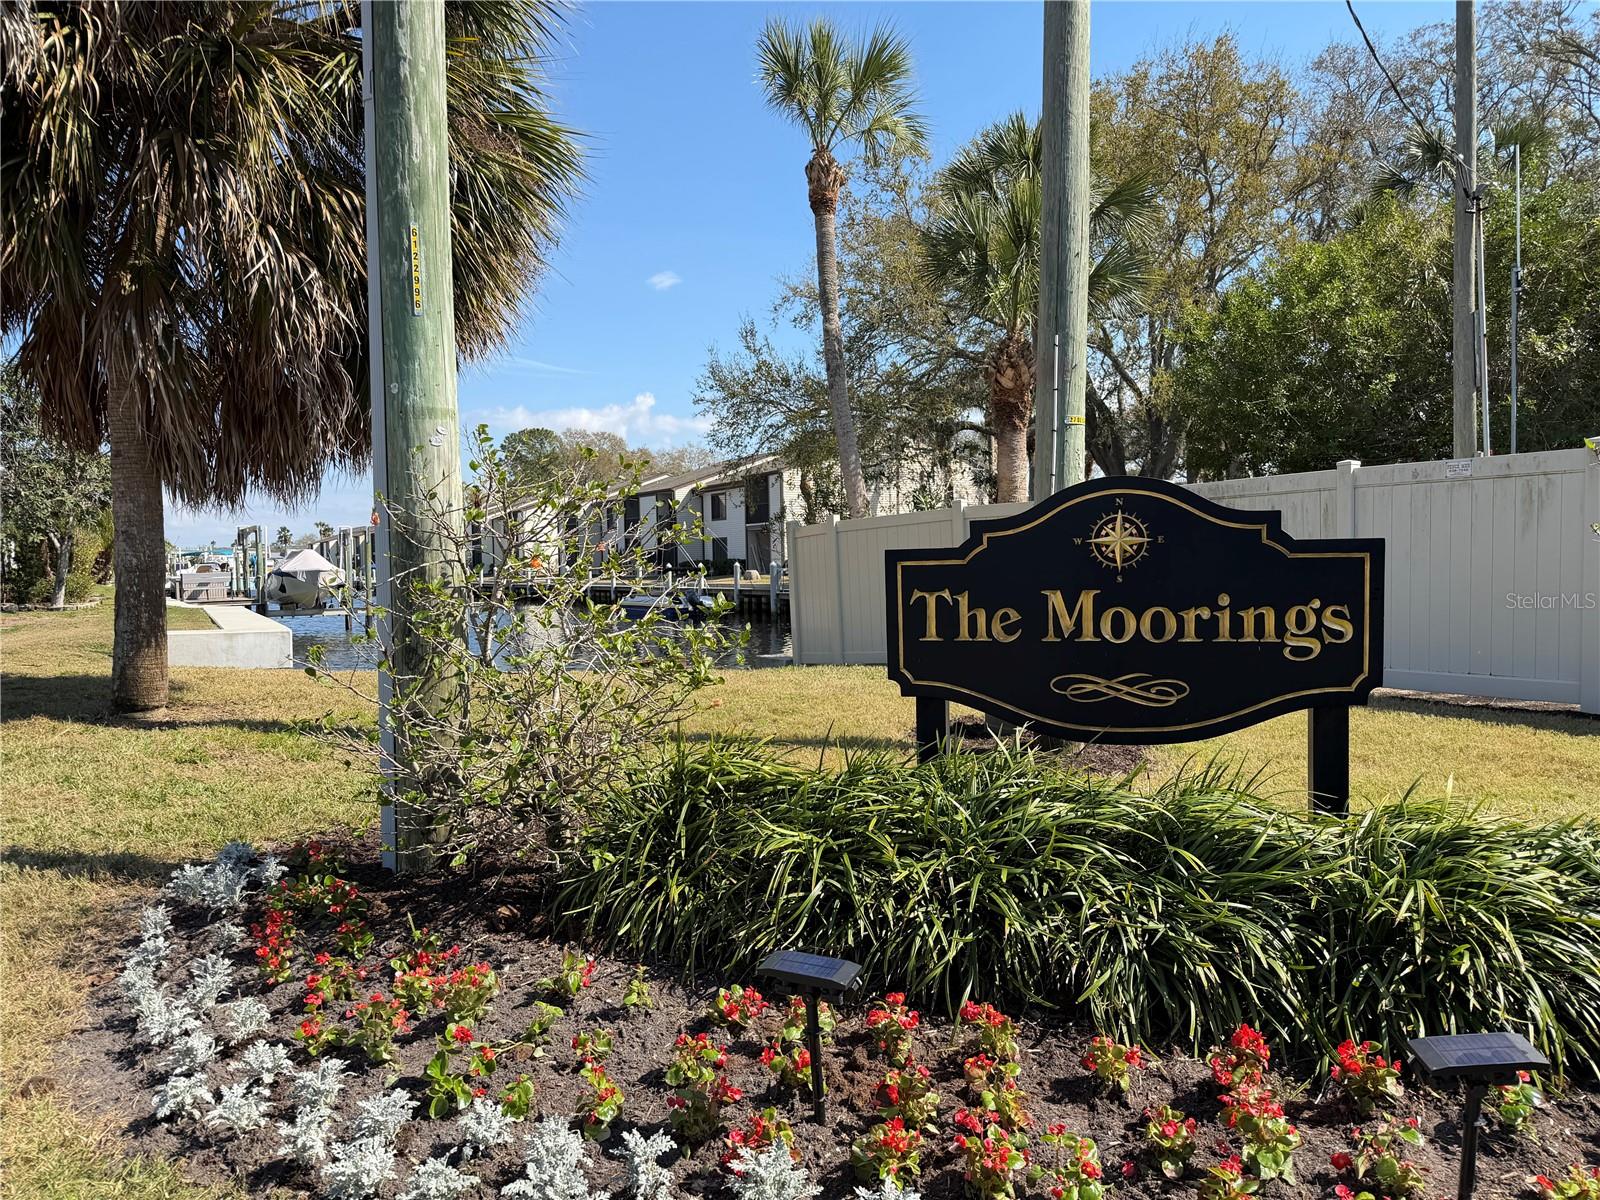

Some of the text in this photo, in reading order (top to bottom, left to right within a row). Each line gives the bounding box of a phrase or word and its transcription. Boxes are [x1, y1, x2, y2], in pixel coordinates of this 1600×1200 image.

[411, 227, 421, 309] 6122996
[1114, 497, 1124, 506] N
[1073, 537, 1083, 545] W
[1157, 535, 1165, 544] E
[1116, 575, 1123, 583] S
[909, 588, 1354, 661] The Moorings
